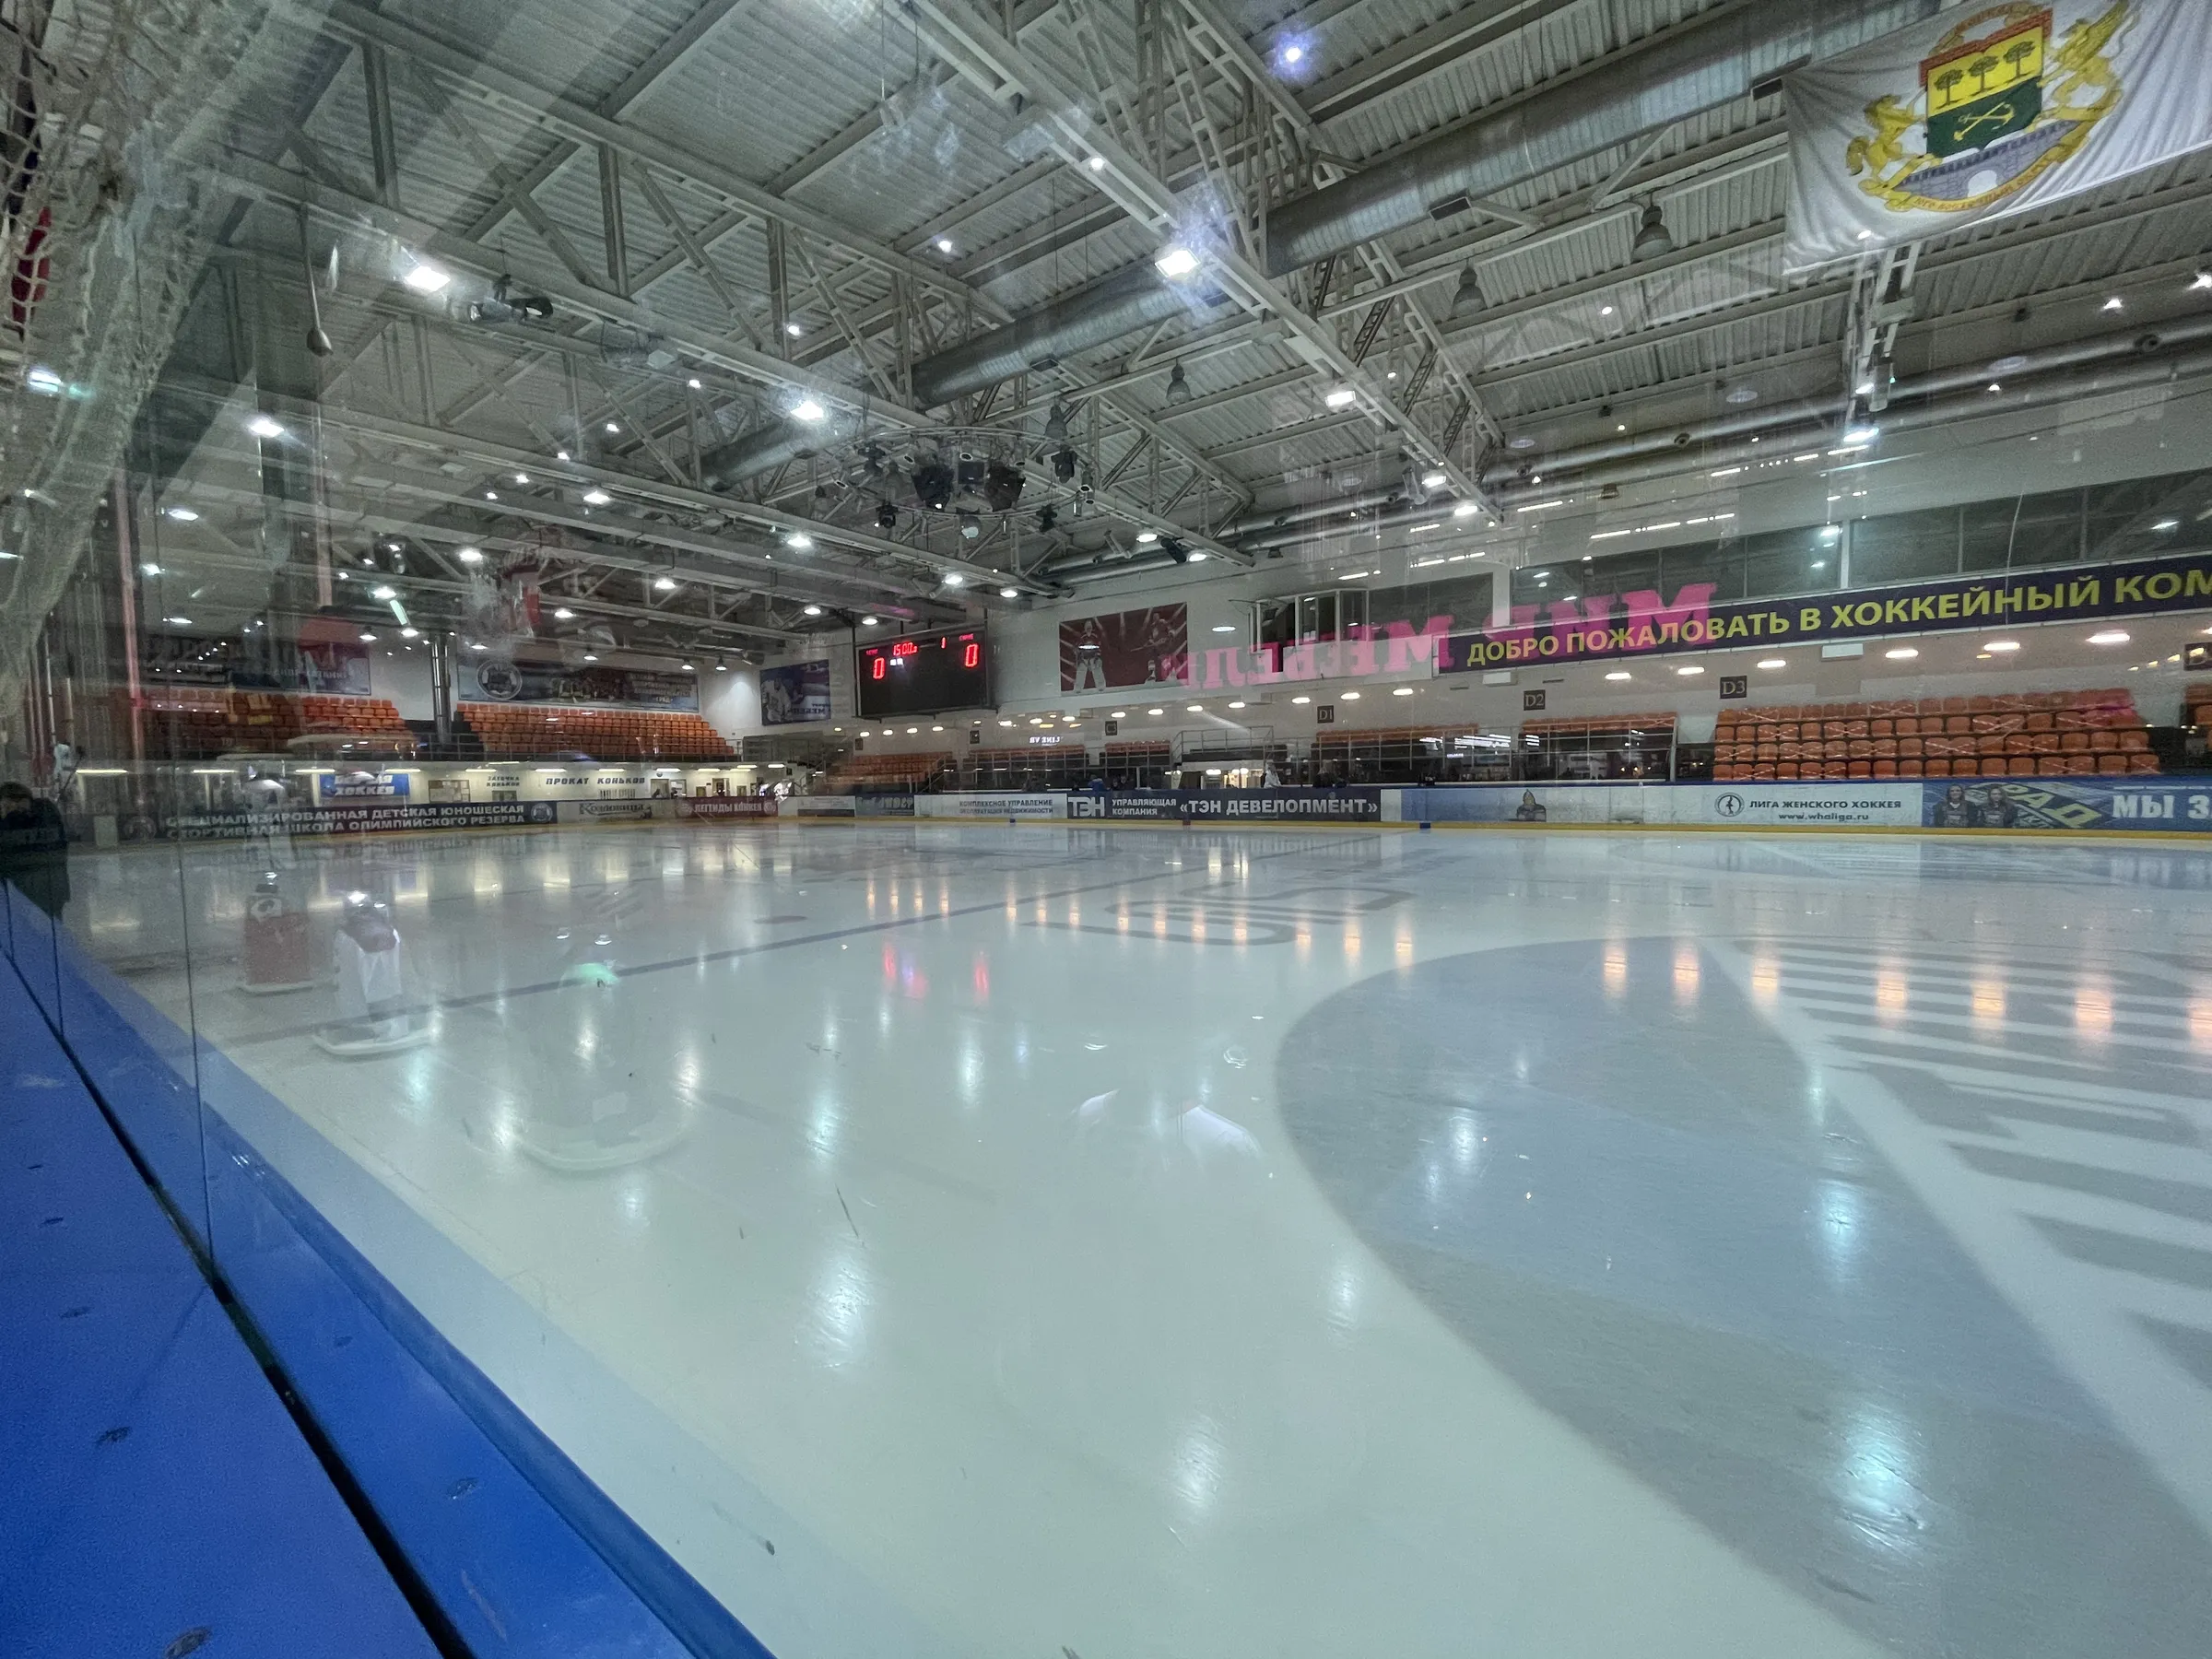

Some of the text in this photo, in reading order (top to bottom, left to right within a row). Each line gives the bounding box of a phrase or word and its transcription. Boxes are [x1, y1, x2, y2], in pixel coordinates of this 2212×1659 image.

[1467, 635, 1559, 666] ДОБРО
[1567, 606, 1790, 653] ПОЖАЛОВАТЬ
[1800, 607, 1821, 631] В
[1830, 575, 2100, 628] ХОККЕЙНЫЙ
[965, 643, 979, 668] 0
[873, 657, 885, 680] 0
[1722, 679, 1746, 695] D3
[1525, 694, 1545, 707] D2
[1319, 709, 1333, 721] D1
[546, 777, 589, 785] ПРОКАТ
[1007, 798, 1053, 806] УПРАВЛЕНИЕ
[1112, 798, 1177, 807] УПРАВЛЯЮЩАЯ
[1180, 799, 1378, 816] «ТЭН ДЕВЕЛОПМЕНТ»
[1749, 800, 1901, 808] ЛИГА ЖЕНСКОГО ХОККЕЯ
[2112, 794, 2212, 819] МЫ З
[372, 807, 437, 819] ДЕТСКАЯ
[441, 805, 524, 816] ЮНОШЕСКАЯ
[1112, 807, 1158, 816] КОМПАНИЯ
[1779, 812, 1869, 822] www.whaliga.ru
[349, 817, 466, 830] ОЛИМПИЙСКОГО
[470, 815, 525, 826] РЕЗЕРВА
